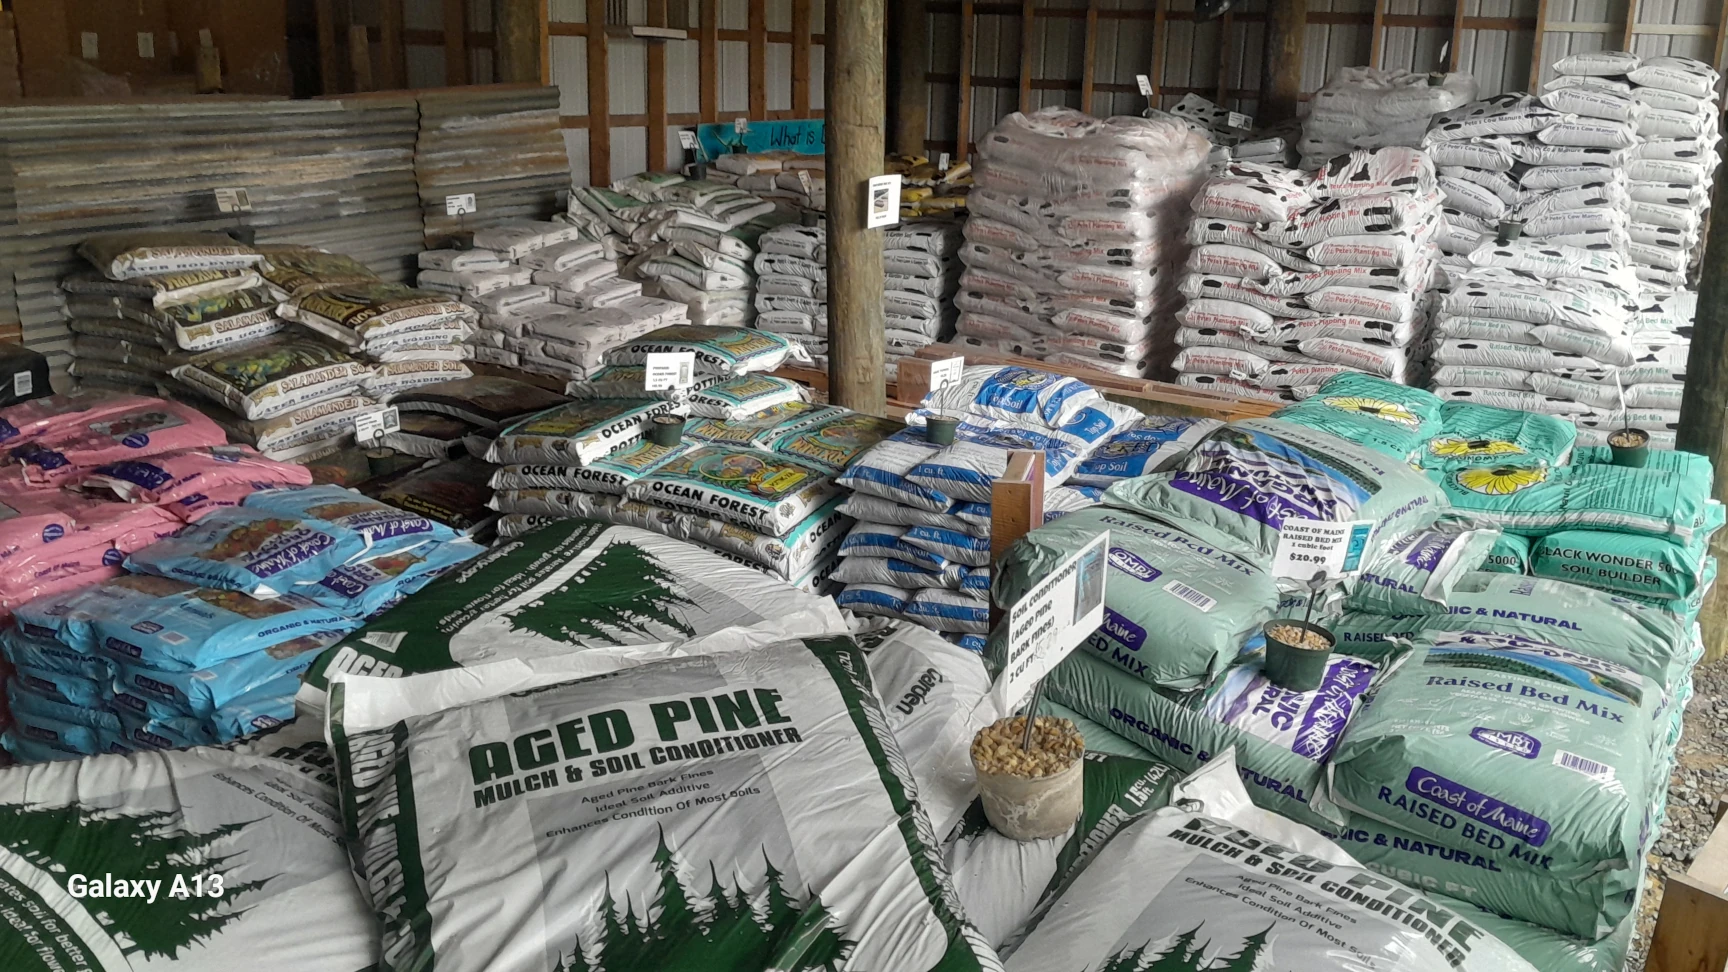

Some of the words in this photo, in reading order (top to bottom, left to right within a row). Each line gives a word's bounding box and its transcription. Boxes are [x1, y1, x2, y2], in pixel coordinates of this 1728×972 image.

[1600, 99, 1622, 108] Manure
[1497, 114, 1522, 122] Manure
[769, 124, 801, 147] What
[805, 125, 815, 145] is
[1335, 296, 1353, 305] Pete's
[1353, 298, 1380, 310] Planting
[1348, 318, 1362, 326] Mix
[631, 344, 678, 354] OCEAN
[1327, 344, 1345, 354] Pete's
[1345, 347, 1372, 361] Planting
[442, 360, 463, 372] SOIL
[281, 365, 348, 393] SALAMANDER
[686, 373, 733, 397] POTTING
[294, 397, 359, 425] SALAMANDER
[1005, 394, 1024, 410] Soil
[601, 413, 643, 438] OCEAN
[1649, 414, 1663, 422] Mix
[1083, 424, 1098, 437] Top
[521, 464, 567, 478] OCEAN
[573, 467, 630, 486] FOREST
[1108, 460, 1128, 472] Soil
[1179, 470, 1234, 503] Maine
[652, 481, 704, 502] OCEAN
[709, 494, 769, 521] FOREST
[387, 521, 401, 536] of
[400, 518, 431, 531] Coast
[809, 511, 843, 544] OCEAN
[1283, 524, 1311, 534] COAST
[1099, 514, 1172, 540] Raised
[1172, 534, 1214, 556] Bed
[1215, 553, 1256, 577] Mix
[1283, 533, 1314, 542] RAISED
[1297, 542, 1318, 551] cubic
[1289, 552, 1327, 565] $20.99
[1487, 554, 1517, 566] 5000
[1586, 552, 1654, 571] WONDER
[519, 576, 537, 589] soil
[1561, 563, 1593, 576] SOIL
[1598, 569, 1662, 586] BUILDER
[490, 583, 506, 595] for
[971, 608, 989, 620] Top
[1011, 600, 1029, 624] SOIL
[1475, 607, 1489, 616] &
[1492, 608, 1583, 632] NATURAL
[257, 619, 302, 638] ORGANIC
[1010, 637, 1031, 665] BARK
[1111, 648, 1149, 678] MIX
[1009, 672, 1015, 684] 2
[1015, 661, 1025, 678] CU
[1025, 653, 1034, 669] FT
[896, 667, 944, 716] Garden
[1533, 679, 1569, 693] BLEND
[1426, 675, 1514, 694] Raised
[1518, 684, 1570, 706] Bed
[1575, 699, 1625, 724] Mix
[468, 708, 636, 786] AGED
[649, 687, 793, 743] PINE
[1109, 706, 1195, 756] ORGANIC
[1196, 749, 1212, 763] &
[473, 770, 559, 809] MULCH
[566, 764, 583, 783] &
[589, 752, 646, 779] SOIL
[648, 726, 804, 766] CONDITIONER
[581, 788, 615, 805] Aged
[617, 782, 645, 796] Pine
[680, 768, 714, 783] Fines
[1124, 786, 1148, 808] 1.5
[1147, 762, 1172, 786] (42L)
[595, 799, 627, 814] Ideal
[631, 793, 656, 806] Soil
[659, 781, 711, 799] Additive
[1416, 775, 1466, 807] Coast
[1466, 798, 1486, 818] of
[1483, 805, 1541, 839] Maine
[254, 791, 297, 819] Condition
[296, 814, 309, 824] Of
[308, 820, 333, 840] Most
[546, 817, 609, 839] Enhances
[612, 803, 674, 822] Condition
[676, 799, 692, 812] Of
[695, 792, 727, 808] Most
[1377, 785, 1457, 830] RAISED
[1461, 822, 1505, 851] BED
[1508, 848, 1554, 870] MIX
[1373, 833, 1389, 847] &
[1392, 836, 1502, 872] NATURAL
[1166, 829, 1244, 859] MULCH
[1244, 853, 1264, 867] &
[1266, 860, 1319, 885] SOIL
[1320, 879, 1466, 970] CONDITIONER
[1235, 874, 1267, 888] Aged
[1268, 882, 1294, 897] Pine
[1295, 893, 1323, 911] Bark
[1326, 905, 1358, 925] Fines
[1445, 880, 1478, 898] FT
[1184, 876, 1239, 900] Enhances
[1241, 895, 1297, 924] Condition
[1299, 918, 1316, 931] Of
[1315, 927, 1347, 949] Most
[1238, 882, 1267, 899] Ideal
[1268, 890, 1293, 907] Soil
[1293, 905, 1343, 931] Additive
[1347, 872, 1484, 953] PINE
[21, 900, 49, 920] soil
[40, 917, 62, 935] for
[55, 933, 88, 966] better
[23, 930, 44, 946] for
